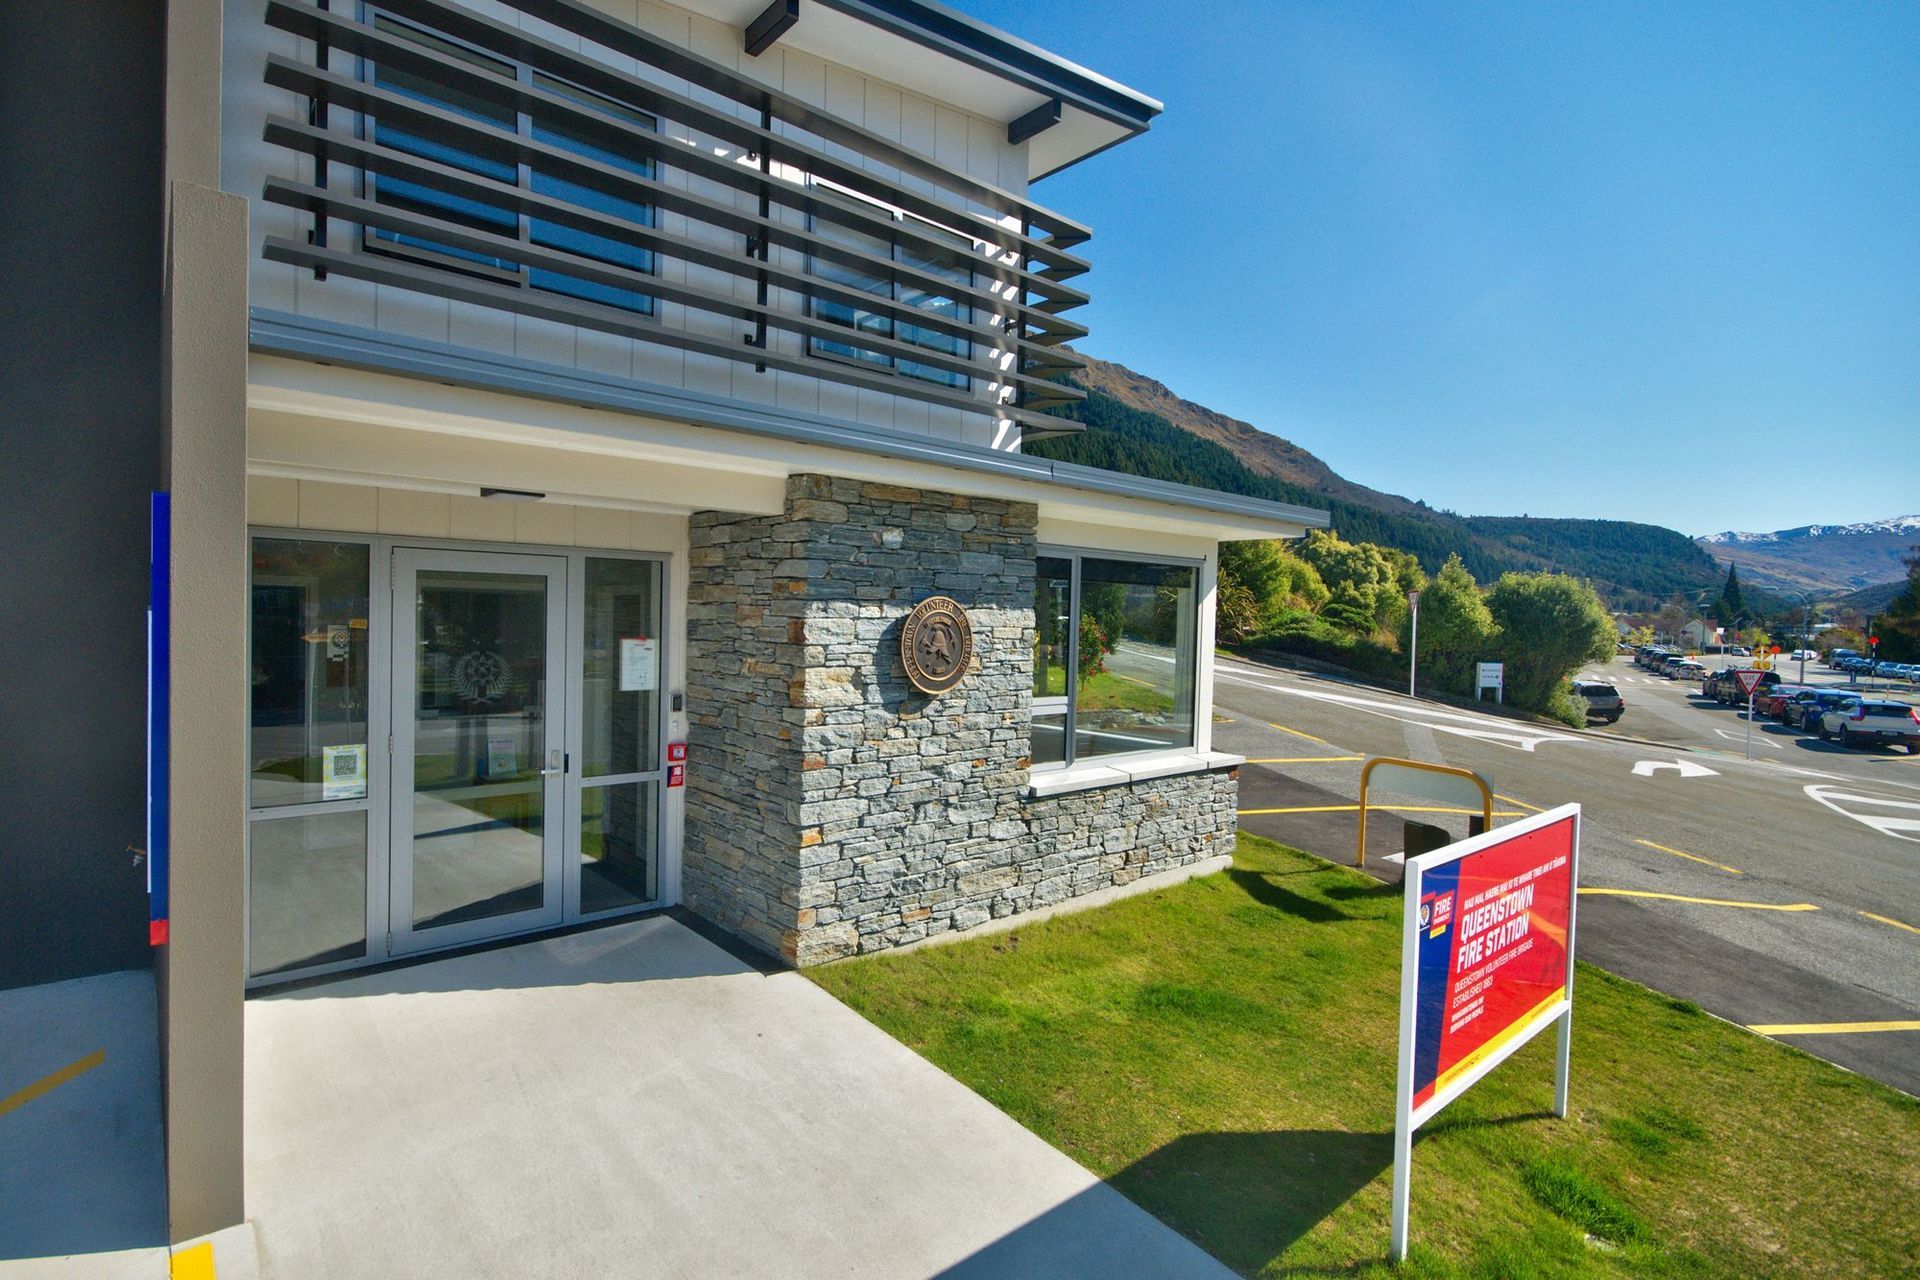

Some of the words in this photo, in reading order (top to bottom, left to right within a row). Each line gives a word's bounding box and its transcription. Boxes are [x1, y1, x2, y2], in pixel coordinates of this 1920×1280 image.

[915, 600, 954, 620] VOLUNTEER
[1433, 896, 1452, 917] FIRE
[1460, 883, 1535, 944] QUEENSTOWN
[1457, 941, 1483, 973] FIRE
[1485, 912, 1530, 956] STATION
[1454, 967, 1486, 994] QUEENSTOWN
[1486, 952, 1510, 974] VOLUNTEER
[1517, 937, 1534, 956] BRIGADE
[1452, 980, 1483, 1009] ESTABLISHED
